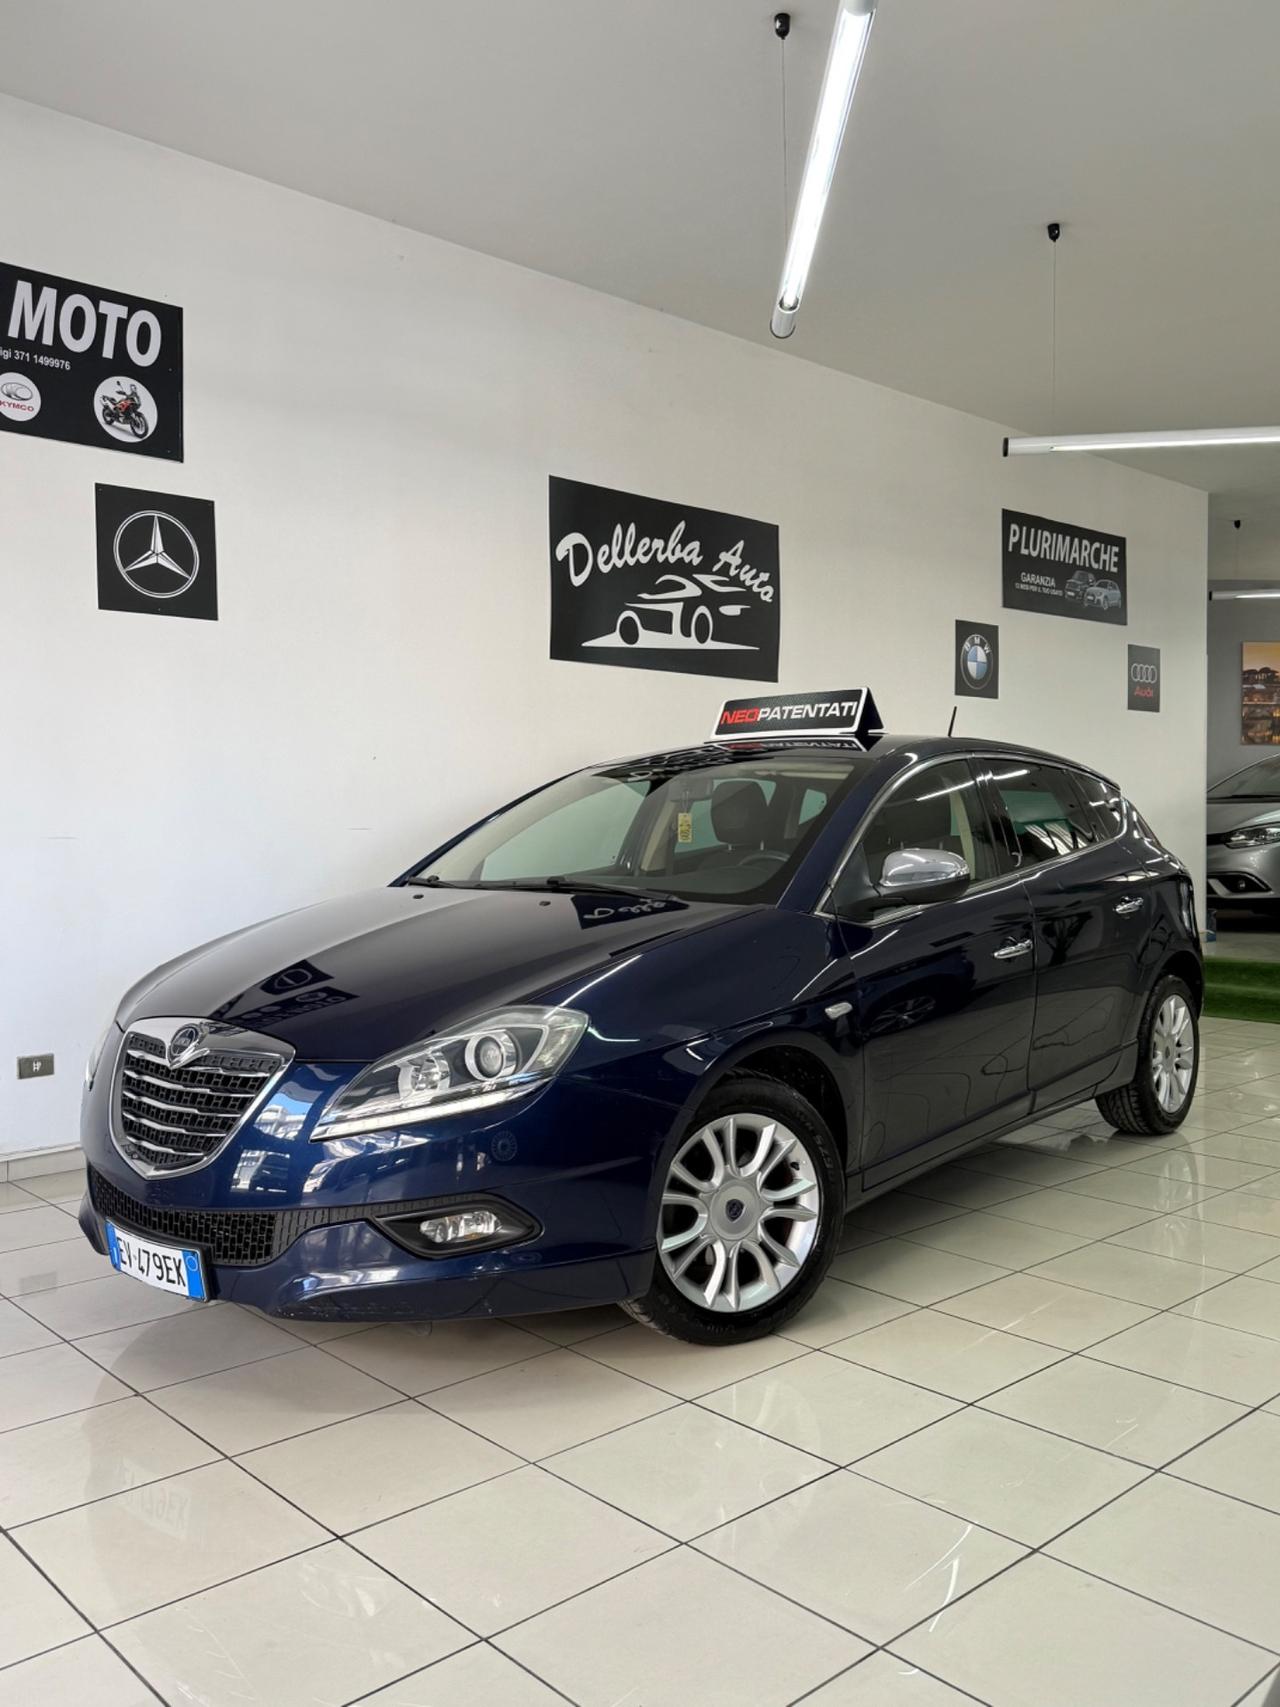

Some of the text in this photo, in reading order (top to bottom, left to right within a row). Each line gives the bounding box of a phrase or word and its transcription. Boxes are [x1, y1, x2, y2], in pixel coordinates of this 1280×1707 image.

[7, 280, 162, 367] MOTO
[14, 350, 30, 362] 371
[33, 354, 71, 370] 1499976
[1008, 523, 1119, 573] PLURIMARCHE
[555, 520, 775, 603] Dellerba Auto
[1020, 571, 1056, 588] GARANZIA
[963, 636, 991, 654] BMW
[1134, 686, 1153, 697] Audi
[721, 701, 858, 725] NEOPATENTATI
